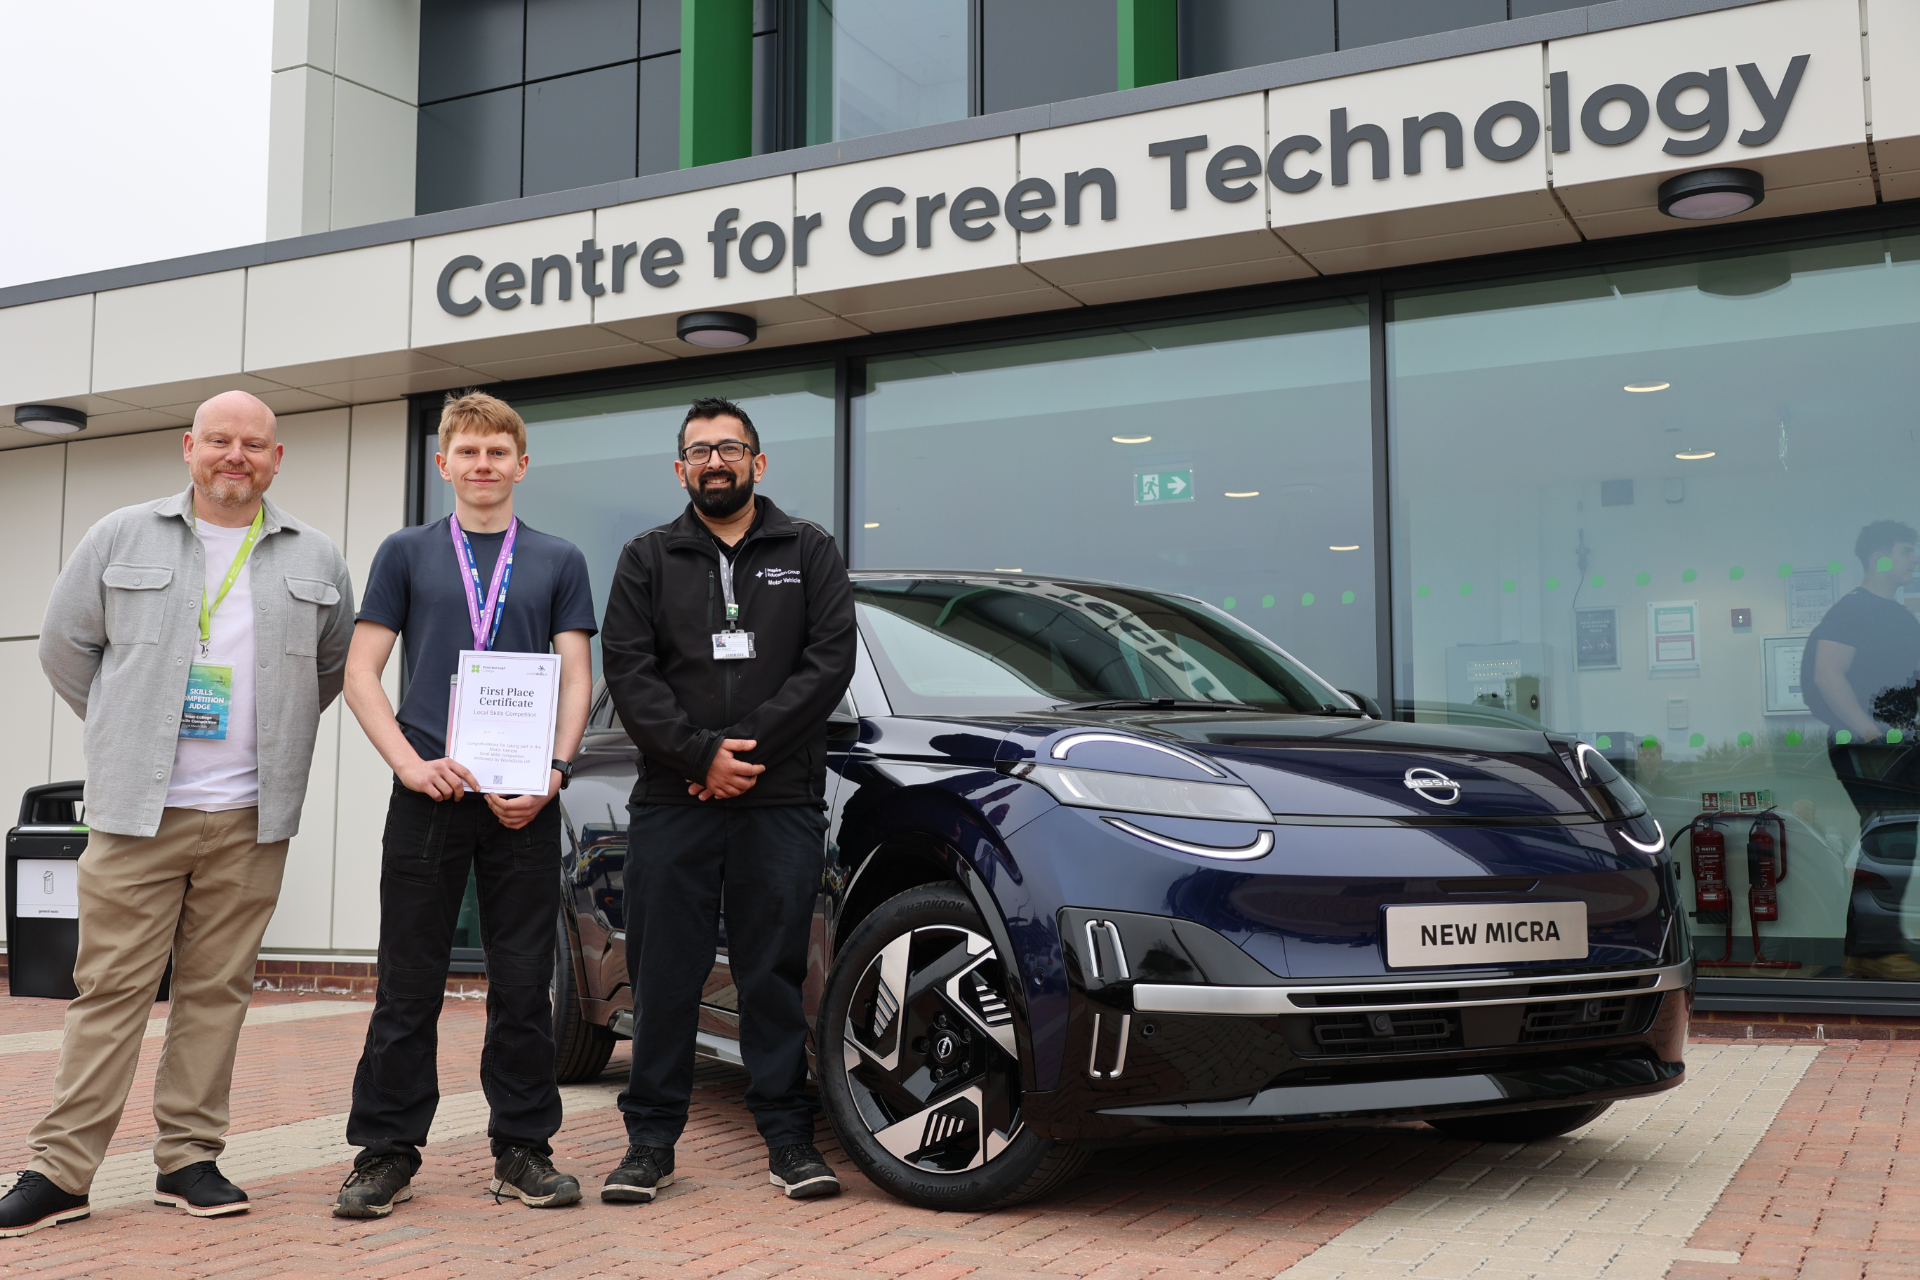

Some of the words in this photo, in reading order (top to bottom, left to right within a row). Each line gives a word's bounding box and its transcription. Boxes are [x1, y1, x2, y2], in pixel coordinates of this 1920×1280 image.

[436, 238, 684, 316] Centre
[707, 207, 822, 278] for
[847, 166, 1118, 256] Green
[1149, 54, 1811, 211] Technology
[480, 686, 504, 696] First
[507, 688, 534, 697] Place
[480, 697, 533, 708] Certificate
[1406, 779, 1461, 788] NISSAN
[1421, 923, 1477, 946] NEW
[1485, 920, 1560, 944] MICRA
